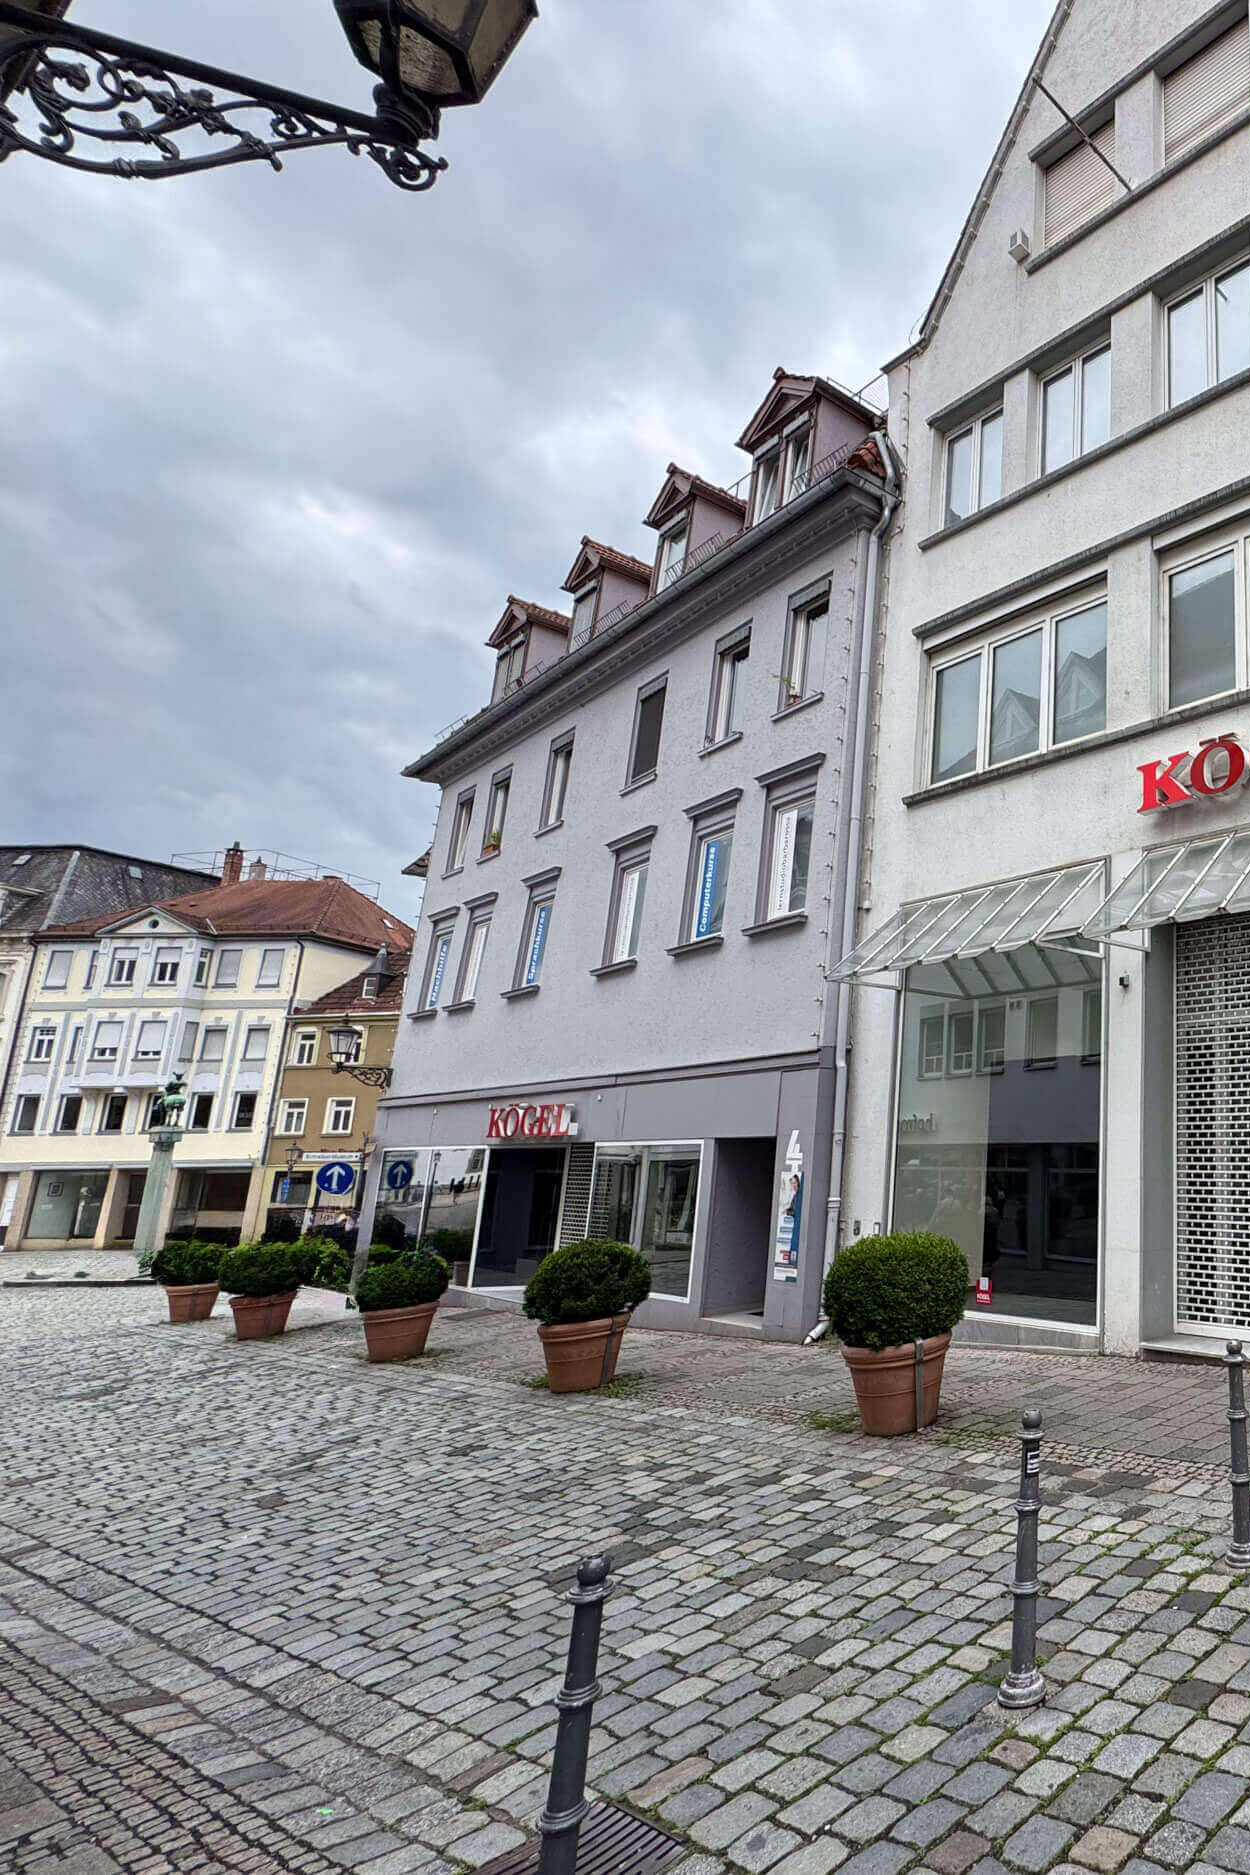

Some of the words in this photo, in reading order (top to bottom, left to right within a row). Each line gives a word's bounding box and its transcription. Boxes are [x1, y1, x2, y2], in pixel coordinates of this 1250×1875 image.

[527, 911, 546, 979] Sprachkurse
[431, 944, 448, 1002] Nachhilfe
[486, 1103, 574, 1138] KÖGEL
[785, 1129, 803, 1173] 4
